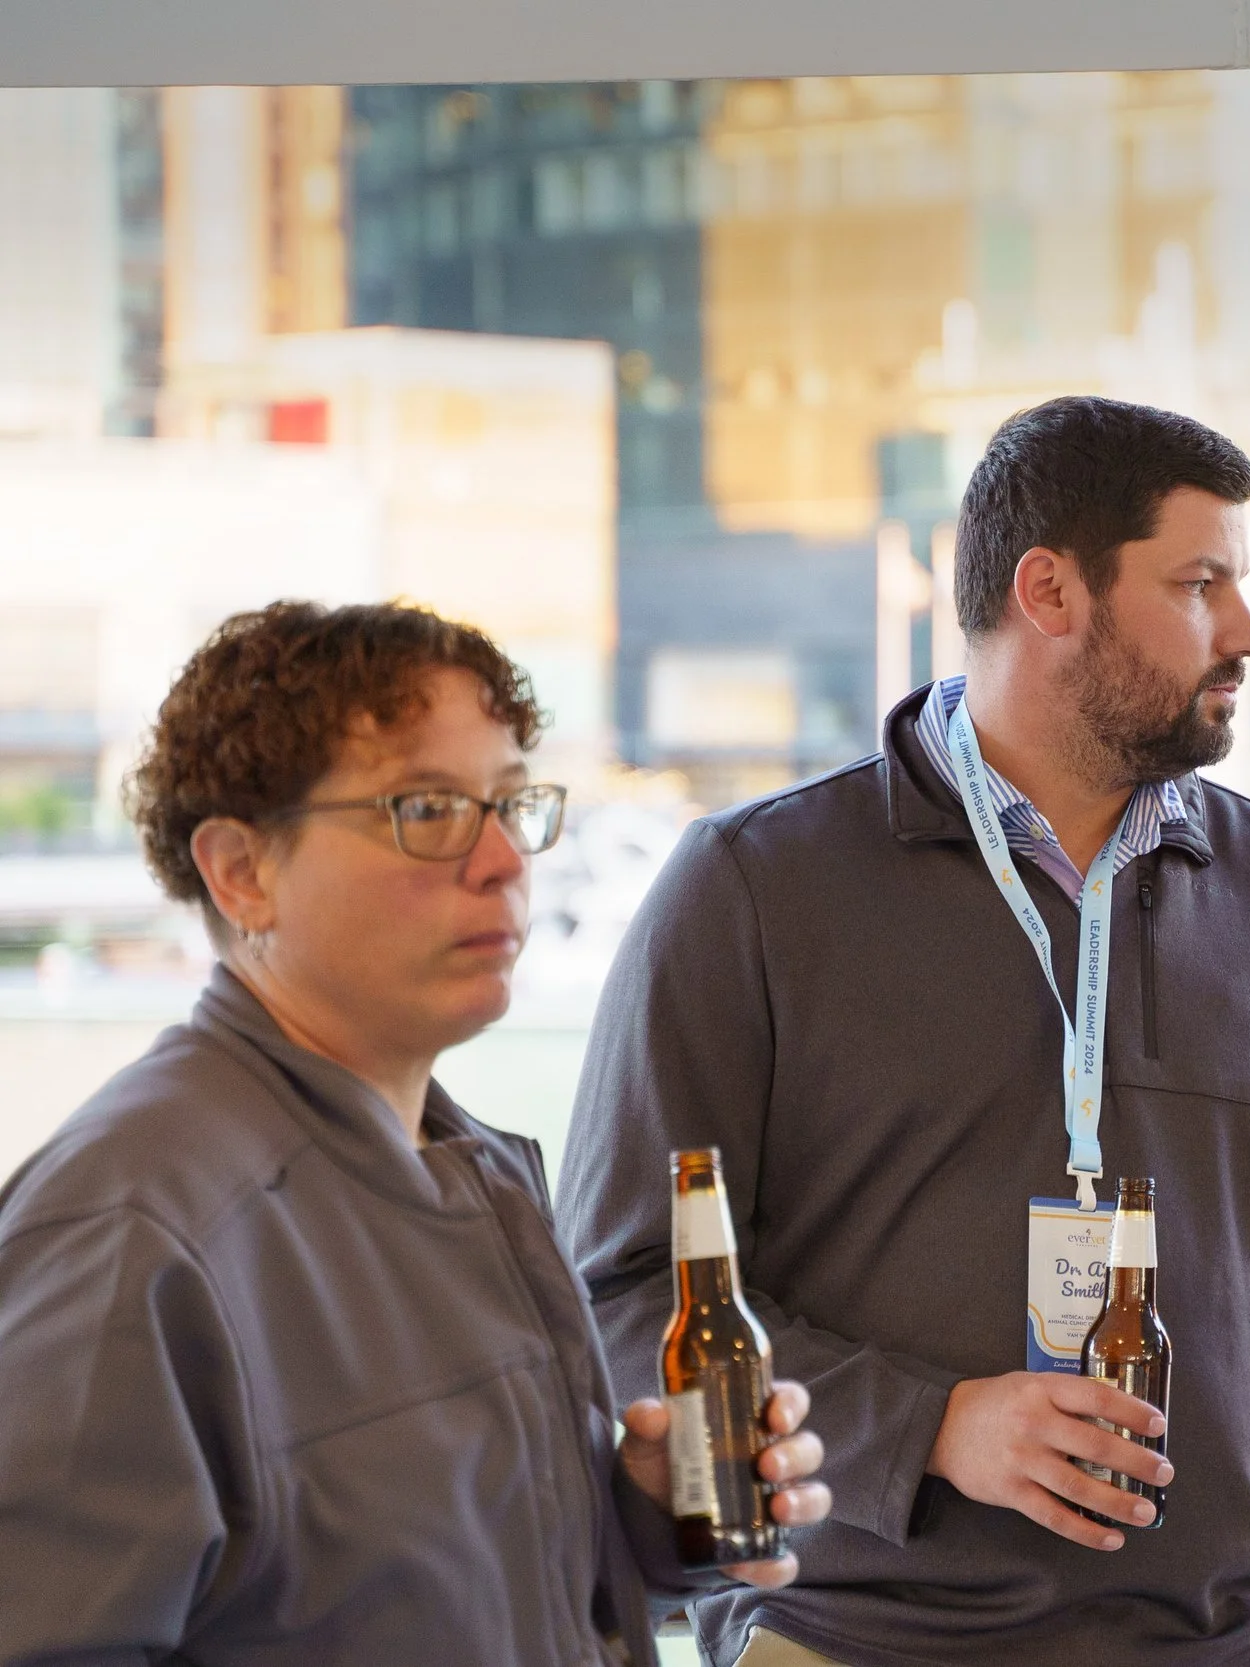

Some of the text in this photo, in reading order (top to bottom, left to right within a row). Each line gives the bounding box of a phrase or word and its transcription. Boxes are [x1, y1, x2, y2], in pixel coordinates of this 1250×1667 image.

[959, 740, 977, 778] SUMMIT
[969, 779, 999, 850] LEADERSHIP
[1022, 907, 1043, 938] 2024
[1084, 919, 1101, 1075] LEADERSHIP SUMMIT 2024
[1067, 1234, 1106, 1245] evervet
[1055, 1258, 1082, 1276] Dr.
